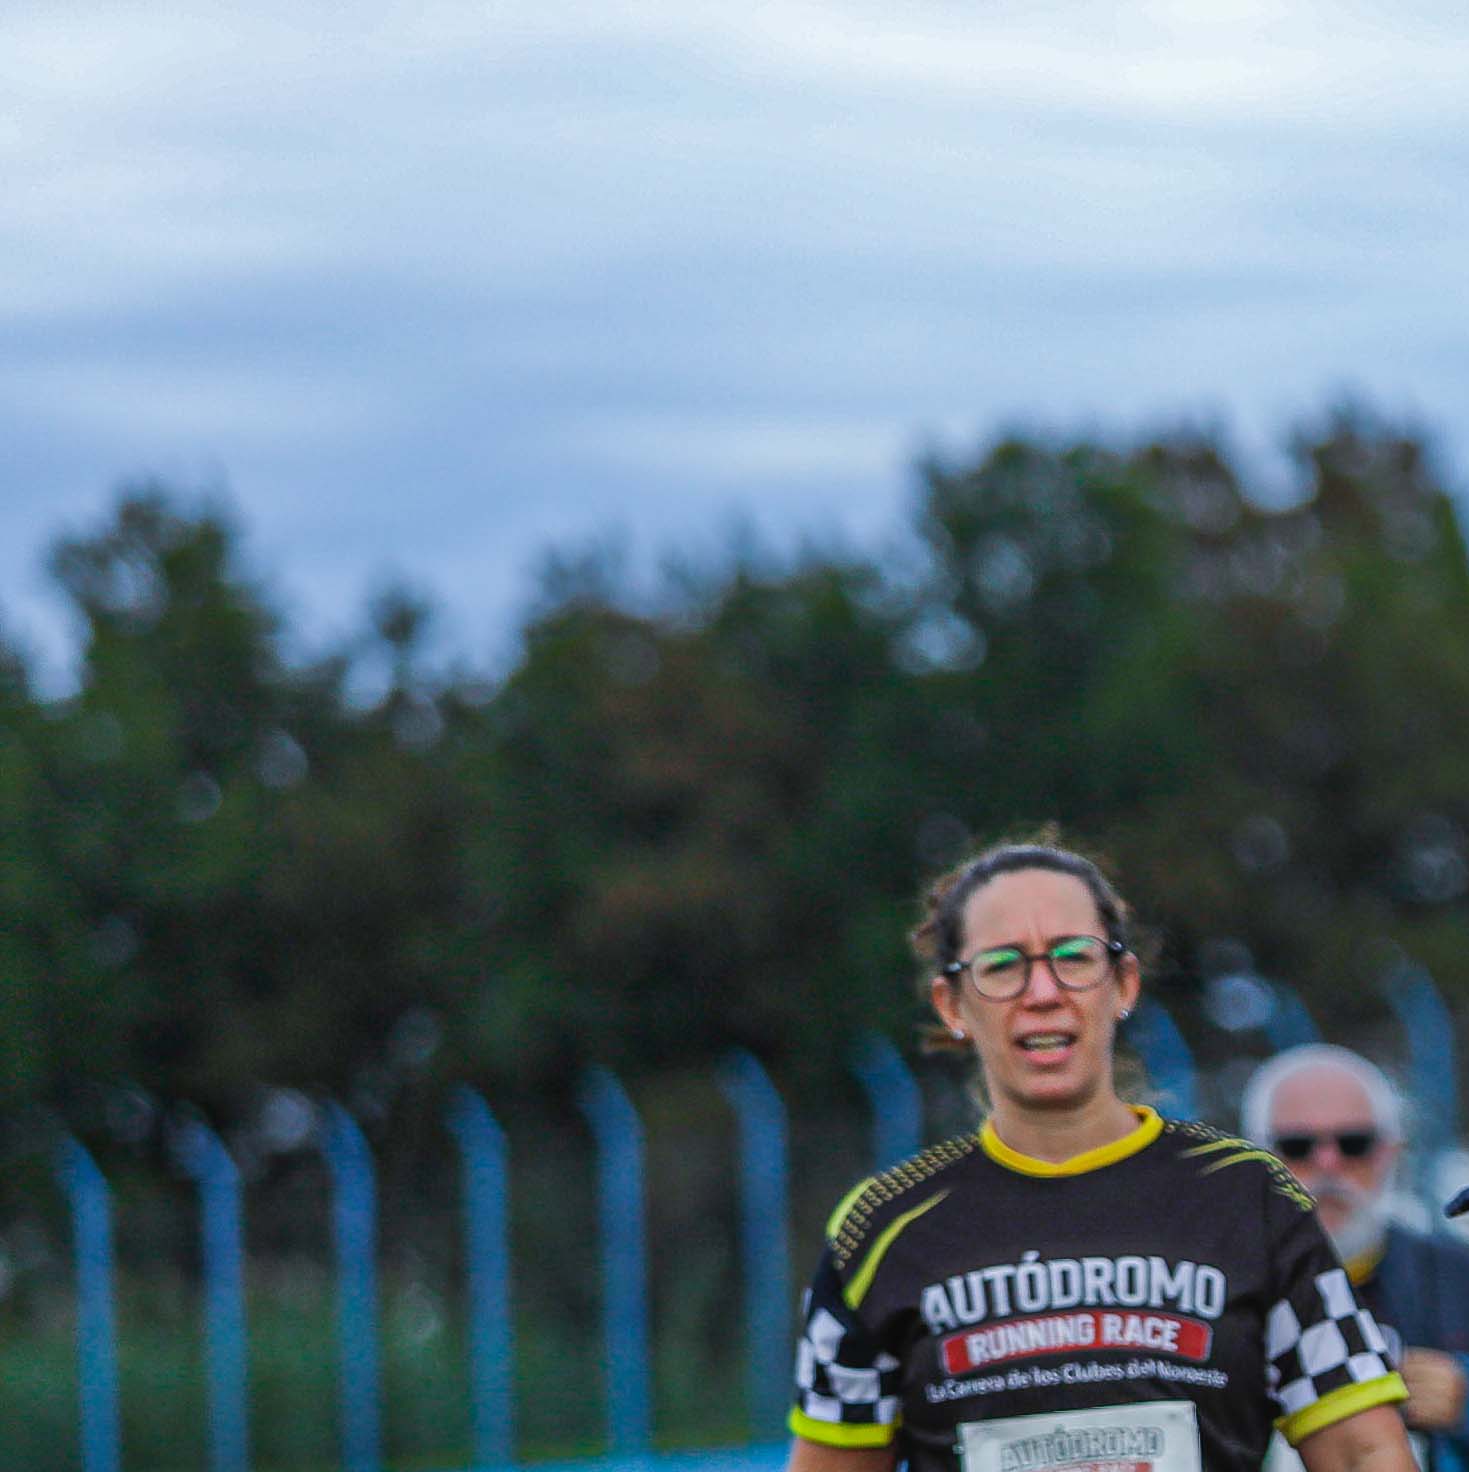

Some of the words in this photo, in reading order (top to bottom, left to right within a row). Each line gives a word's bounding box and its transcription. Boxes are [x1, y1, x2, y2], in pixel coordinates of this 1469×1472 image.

[920, 1250, 1227, 1335] AUTÓDROMO
[966, 1312, 1096, 1367] RUNNING
[1101, 1313, 1182, 1351] RACE
